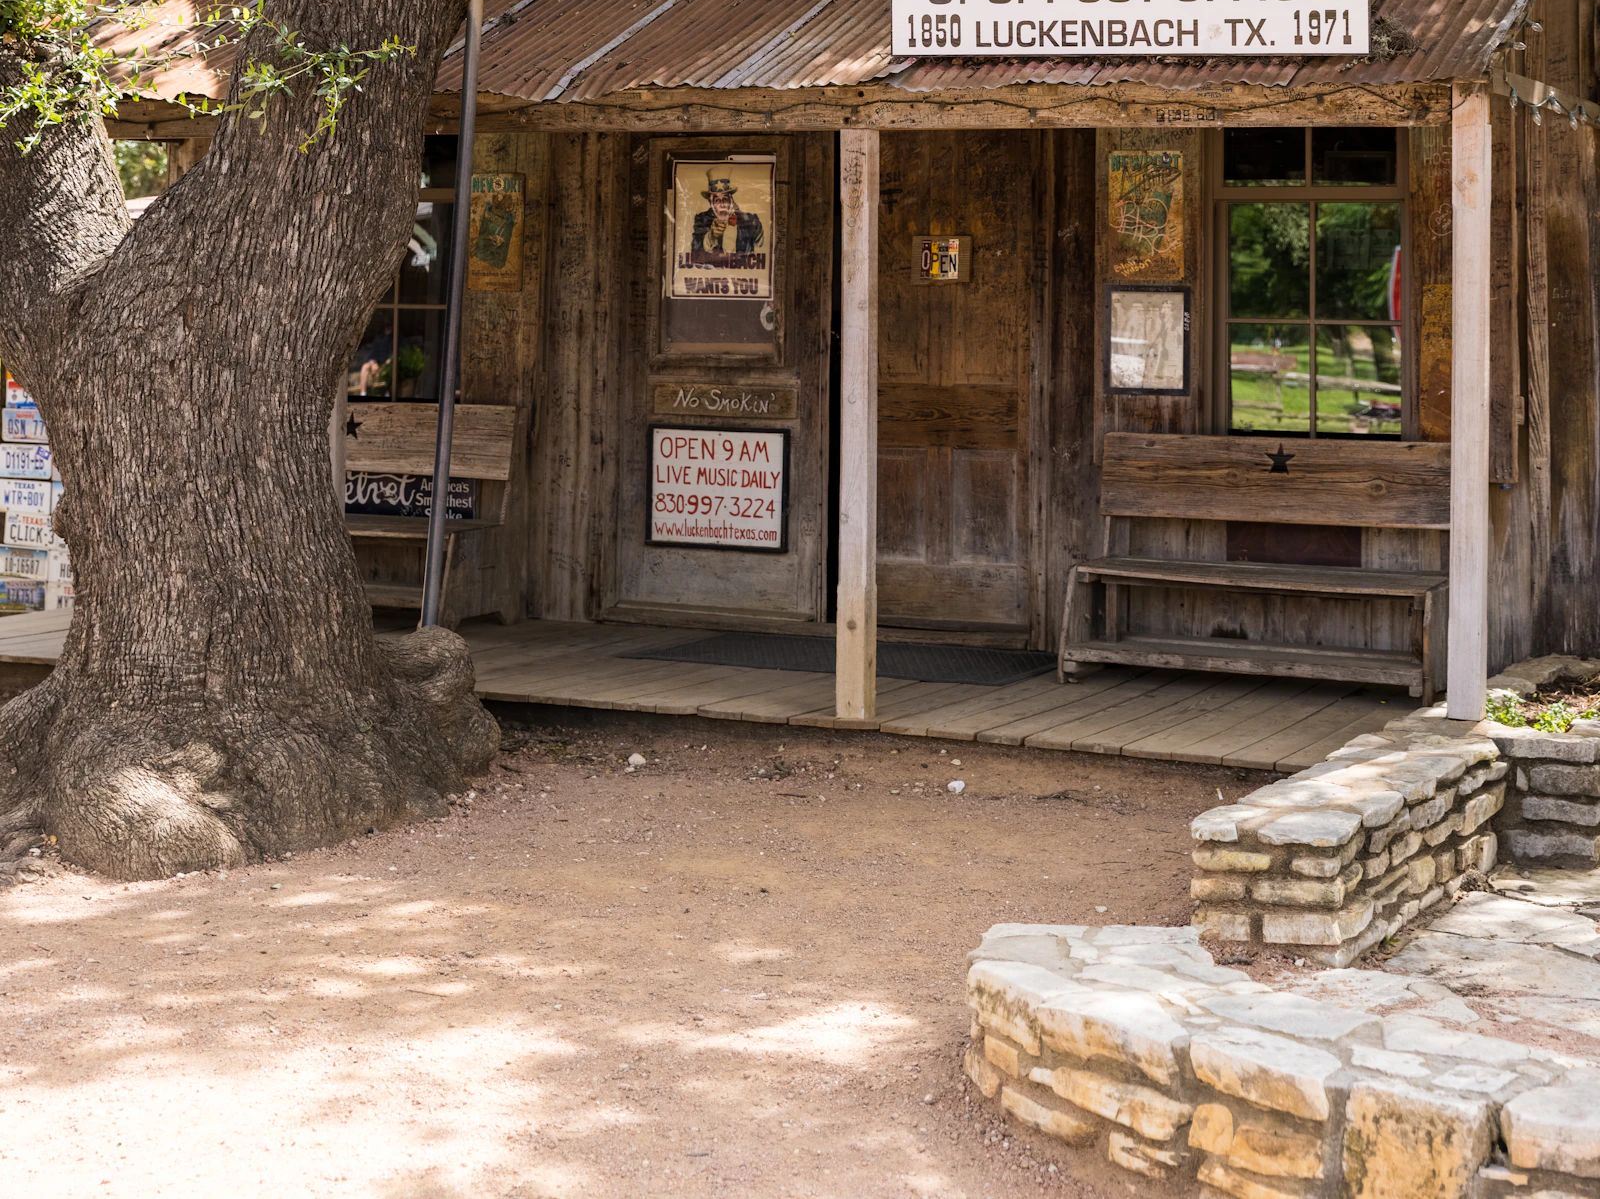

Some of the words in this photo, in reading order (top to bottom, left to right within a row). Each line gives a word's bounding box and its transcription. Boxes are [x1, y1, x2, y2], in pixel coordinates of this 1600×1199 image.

[908, 13, 962, 48] 1850
[976, 18, 1199, 48] LUCKENBACH
[1225, 18, 1276, 47] TX.
[1294, 9, 1353, 46] 1971
[471, 177, 522, 193] NEWORT
[679, 253, 765, 269] LUNBACH
[922, 250, 957, 273] OPEN
[684, 277, 732, 294] WANTS
[732, 278, 758, 295] YOU
[673, 388, 699, 408] No
[660, 437, 715, 460] OPEN
[722, 439, 734, 461] 9
[739, 440, 770, 462] AM
[420, 478, 469, 493] Amica's
[656, 465, 691, 484] LIVE
[697, 467, 738, 487] MUSIC
[741, 470, 781, 489] DAILY
[415, 493, 472, 508] Smthest
[22, 516, 43, 526] TEXAS
[425, 508, 463, 519] Ske
